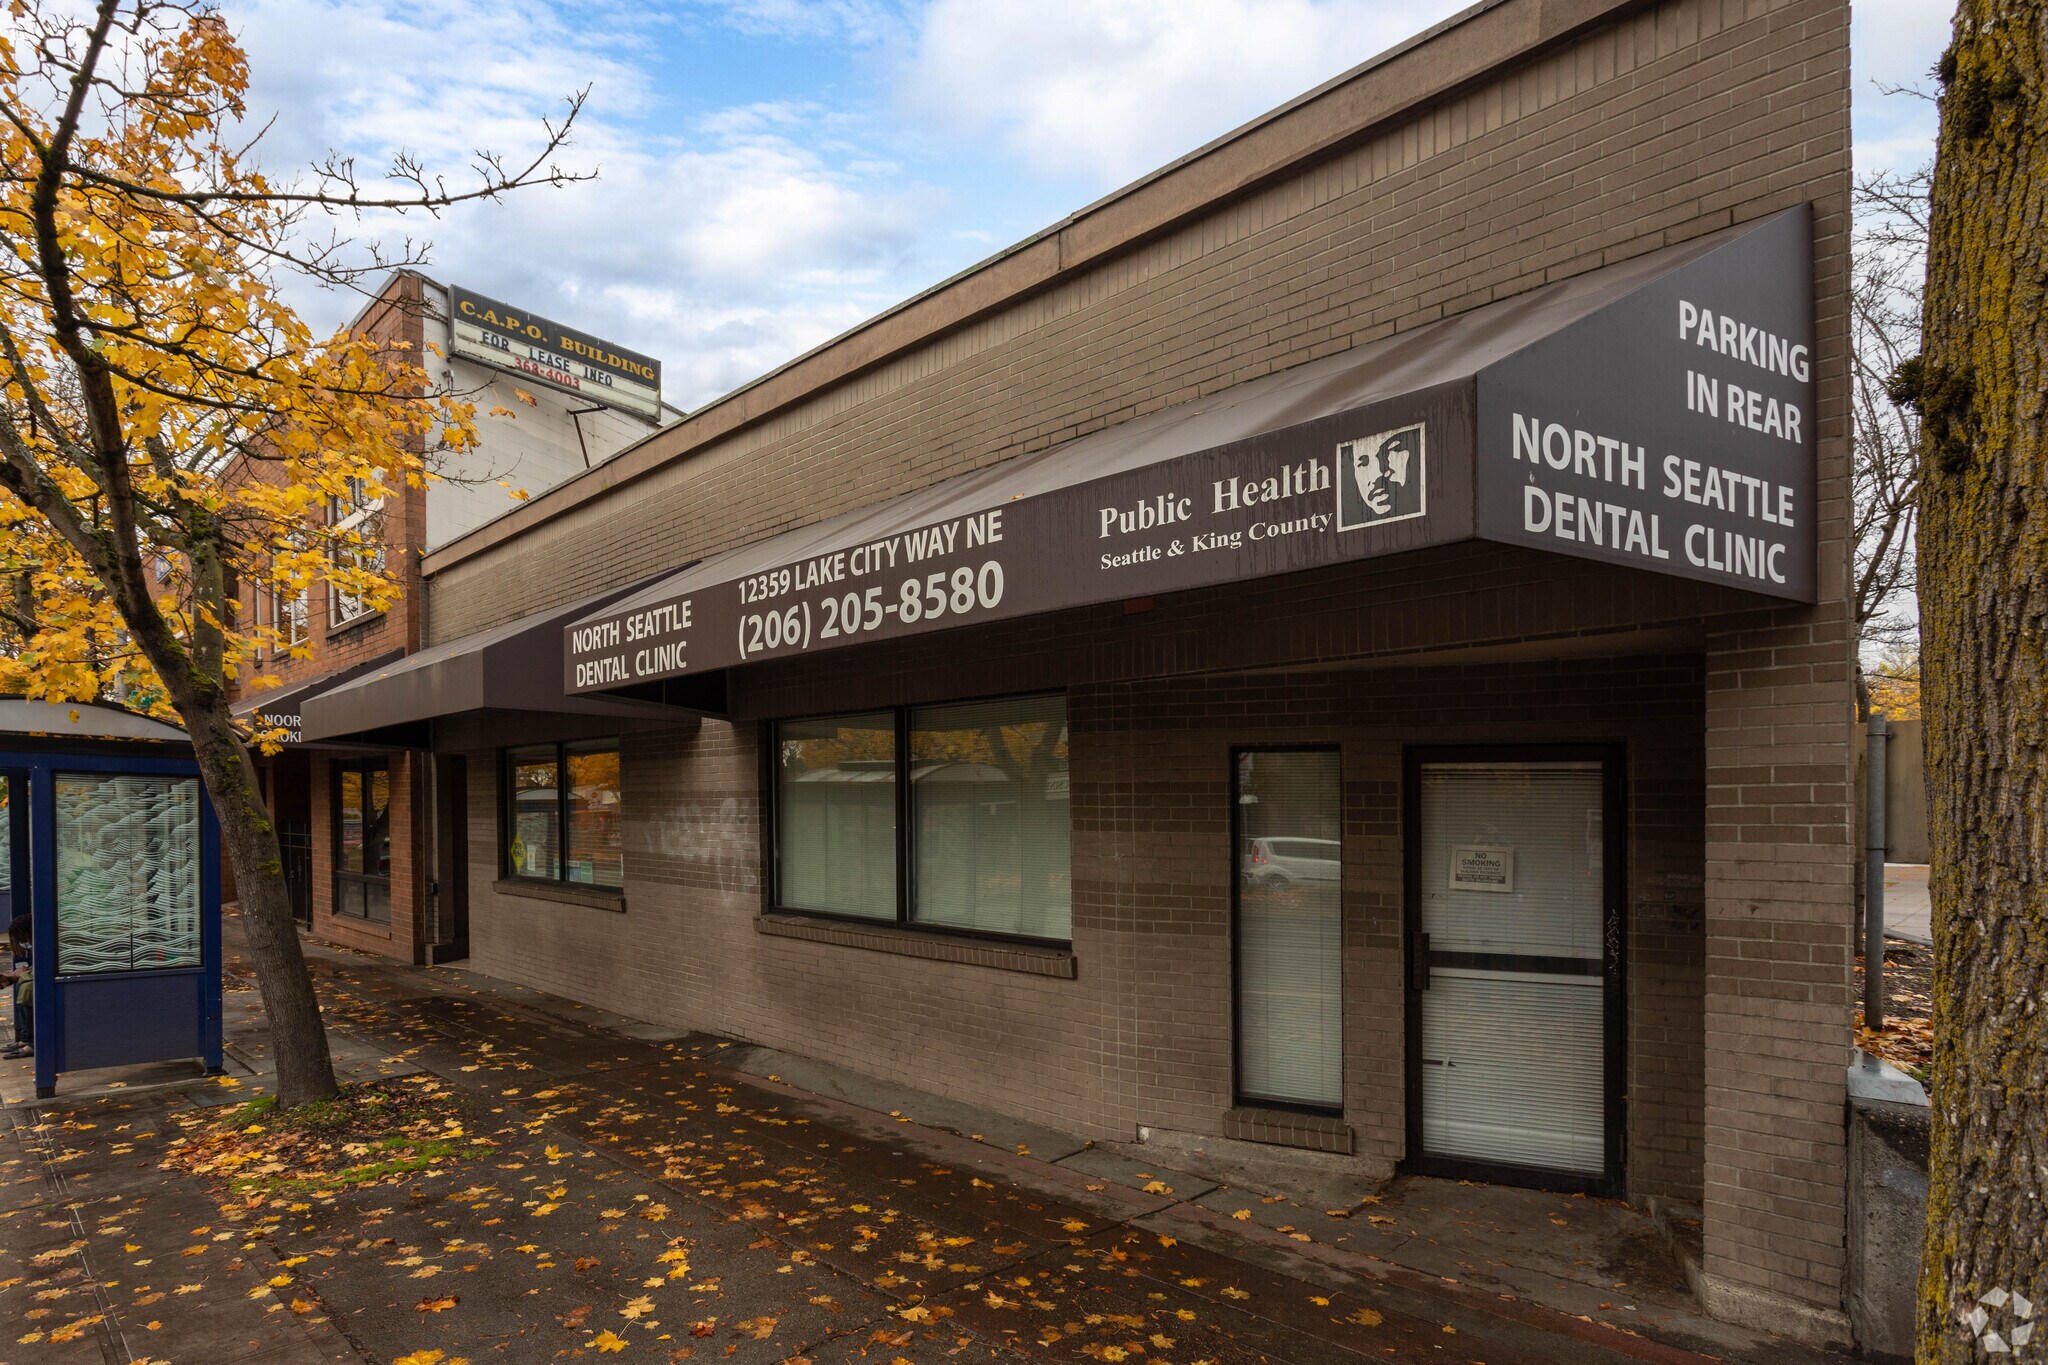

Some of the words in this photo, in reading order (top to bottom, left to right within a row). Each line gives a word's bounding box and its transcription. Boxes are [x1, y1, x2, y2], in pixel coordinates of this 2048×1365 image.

[459, 300, 548, 342] C.A.P.O.
[559, 335, 655, 380] BUILDING
[481, 331, 510, 352] FOR
[528, 348, 571, 373] LEASE
[584, 367, 613, 388] INFO
[1678, 299, 1810, 383] PARKING
[1686, 369, 1719, 418] IN
[1726, 383, 1803, 444] REAR
[1098, 492, 1193, 539] Public
[1211, 457, 1332, 514] Health
[1511, 412, 1646, 491] NORTH
[1662, 454, 1795, 528] SEATTLE
[738, 568, 791, 605] 12359
[794, 552, 845, 591] LAKE
[850, 537, 900, 577] CITY
[904, 520, 961, 563] WAY
[966, 509, 1003, 549] NE
[1100, 545, 1162, 571] Seattle
[1166, 539, 1185, 557] &
[1191, 528, 1242, 553] King
[1248, 512, 1334, 541] County
[1523, 484, 1670, 560] DENTAL
[1683, 523, 1786, 584] CLINIC
[572, 620, 620, 655] NORTH
[626, 600, 692, 643] SEATTLE
[738, 601, 811, 660] (206)
[820, 559, 1005, 640] 205-8580
[575, 653, 630, 688] DENTAL
[635, 641, 687, 677] CLINIC
[264, 714, 302, 727] NOOR
[1461, 859, 1501, 868] SMOKING
[1475, 852, 1487, 860] NO
